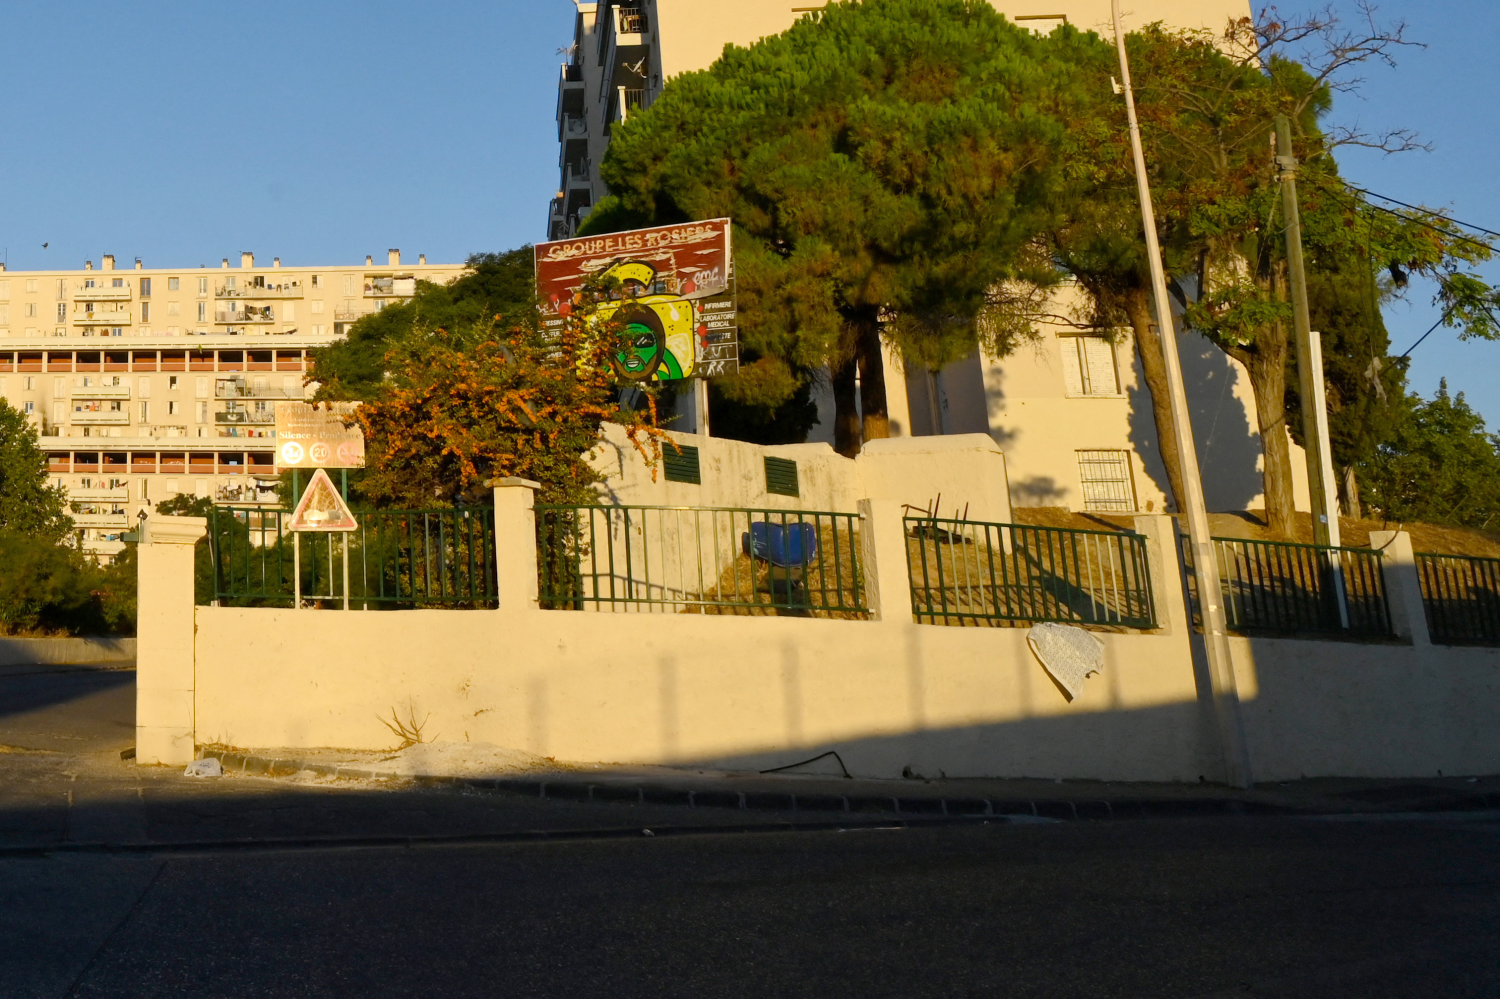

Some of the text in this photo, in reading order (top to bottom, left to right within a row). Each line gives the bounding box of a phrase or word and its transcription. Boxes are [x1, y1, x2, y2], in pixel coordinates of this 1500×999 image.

[549, 224, 713, 257] GROUPE LES ROSIERS
[700, 313, 735, 322] LABORATOIRE
[707, 320, 730, 328] MEDICAL
[279, 431, 311, 439] Silence
[319, 431, 361, 439] Prunce
[314, 448, 327, 457] 20
